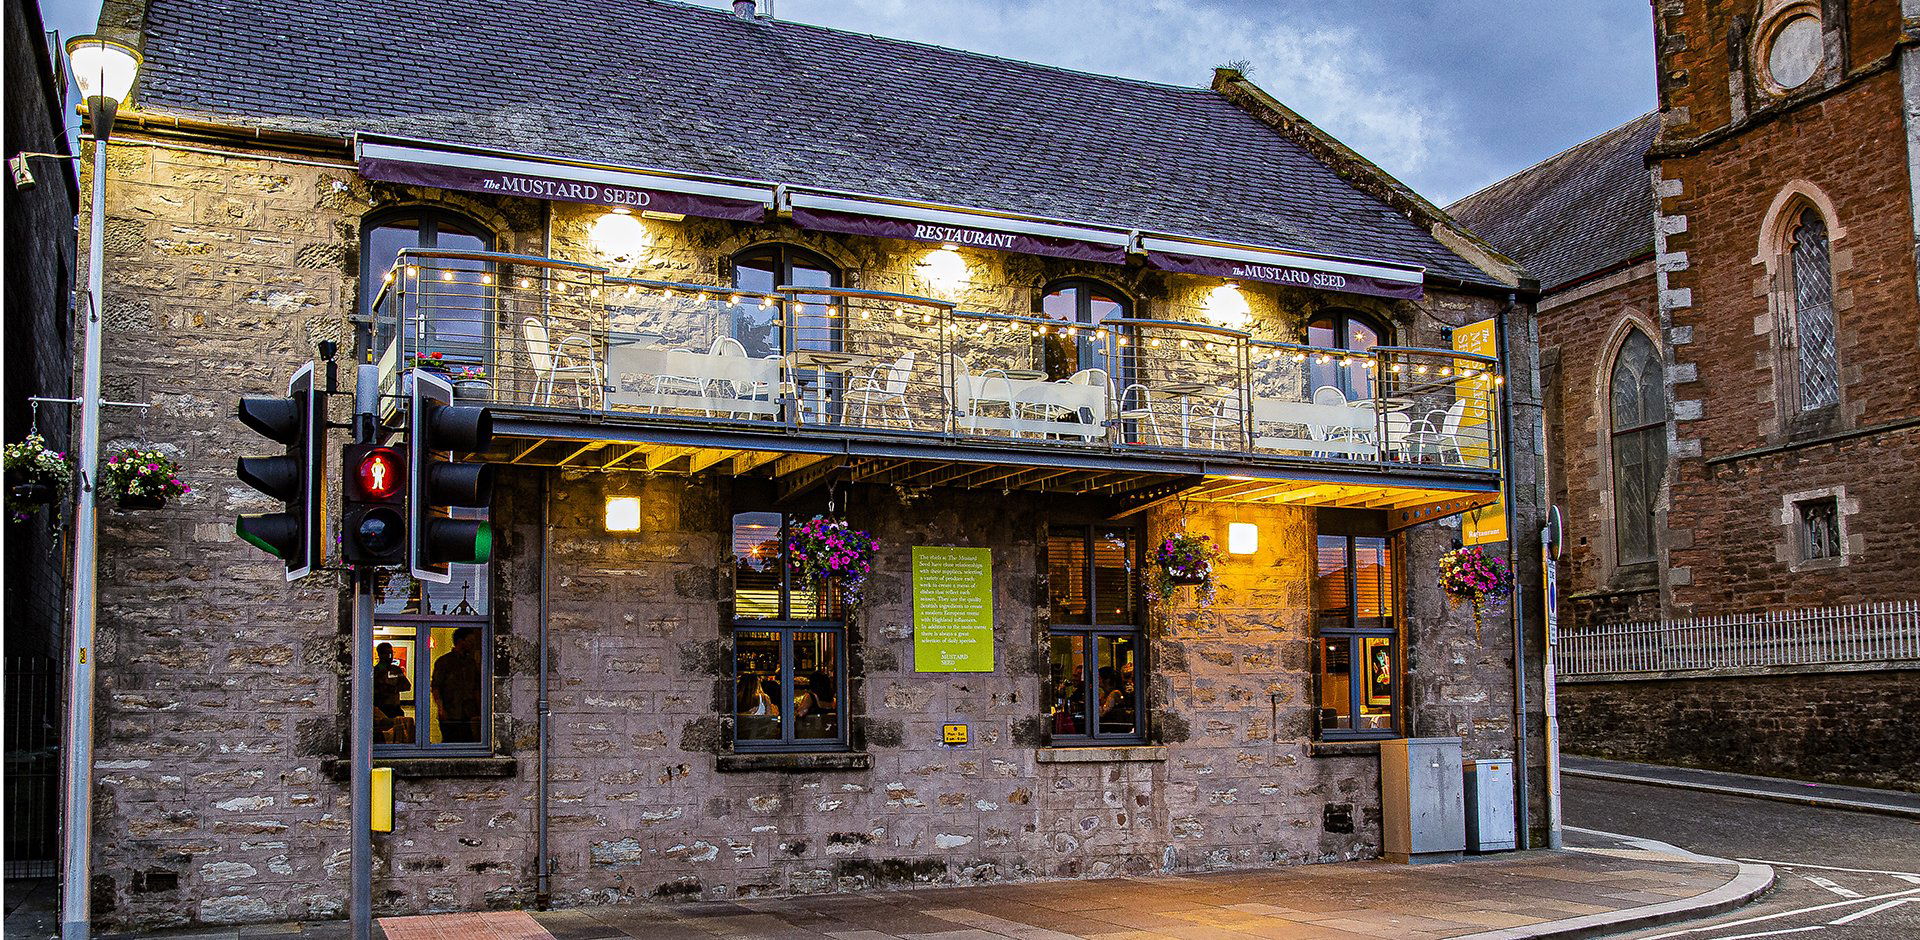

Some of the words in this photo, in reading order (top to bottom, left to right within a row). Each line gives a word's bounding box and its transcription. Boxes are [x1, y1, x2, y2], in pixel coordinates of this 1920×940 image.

[484, 179, 500, 190] The
[501, 176, 598, 200] MUSTARD
[603, 187, 651, 206] SEED
[914, 225, 1016, 248] RESTAURANT
[1232, 267, 1244, 276] The
[1245, 265, 1310, 283] MUSTARD
[1313, 273, 1345, 287] SEED
[1482, 328, 1490, 342] The
